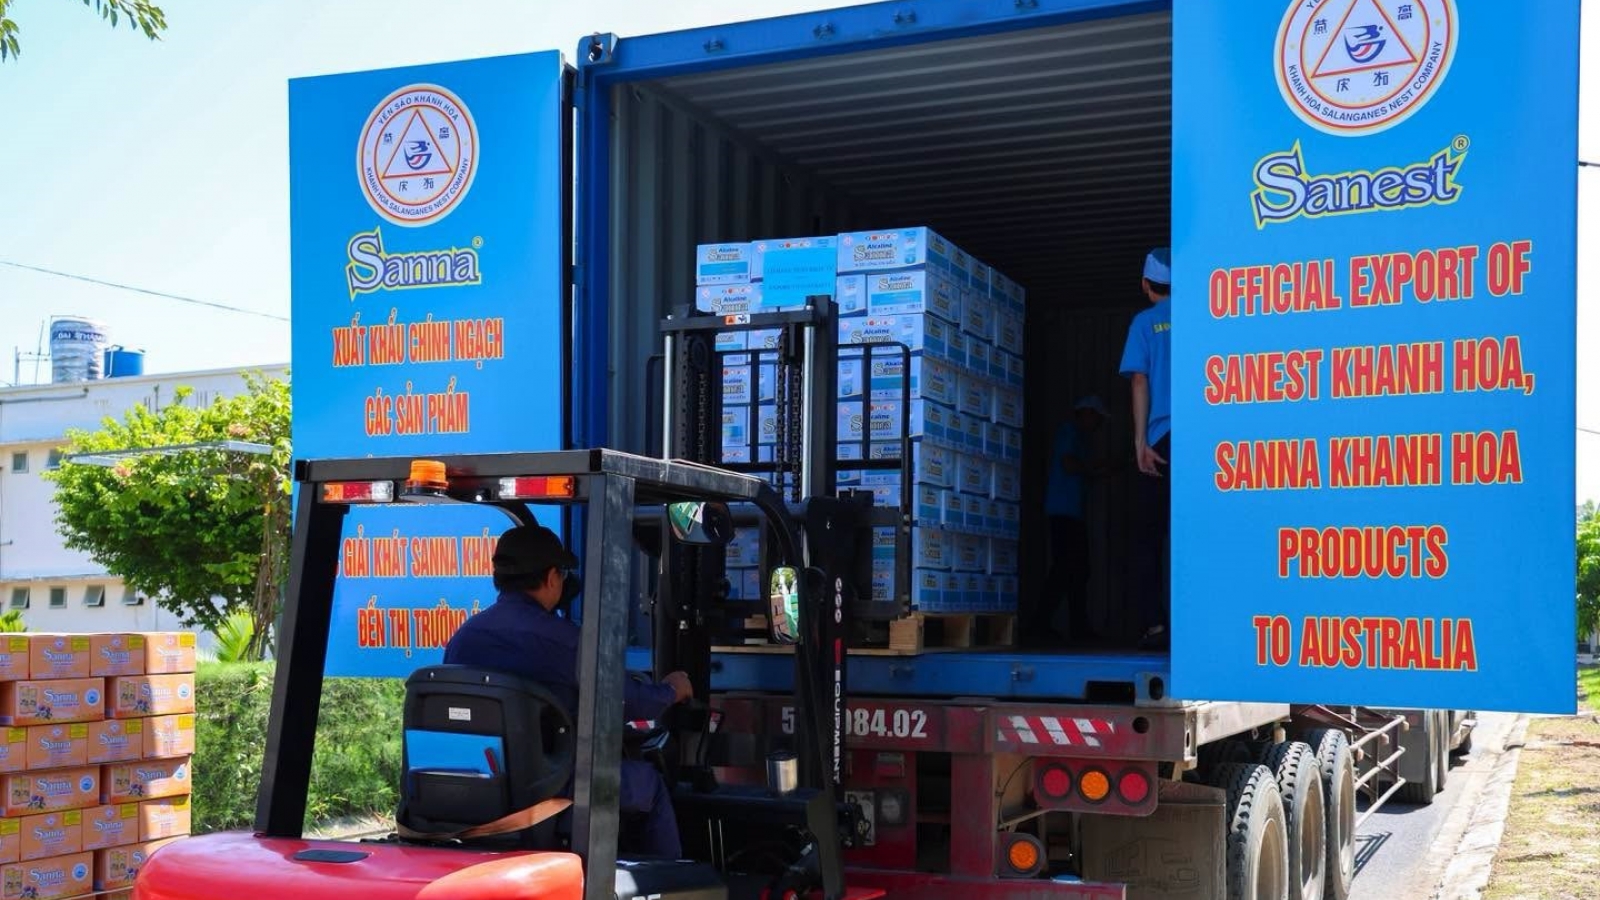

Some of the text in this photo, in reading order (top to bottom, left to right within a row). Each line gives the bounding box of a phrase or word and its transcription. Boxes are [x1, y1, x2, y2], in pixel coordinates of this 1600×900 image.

[1288, 41, 1443, 122] KHANH HOA SALANGANES NEST COMPANY
[366, 158, 469, 216] KHANH HOA SALANGANES NEST COMPANY
[1250, 138, 1468, 230] Sanest
[346, 226, 481, 301] Sanna
[1209, 239, 1532, 319] OFFICIAL EXPORT OF
[333, 308, 504, 369] XUẤT KHẨU CHÍNH NGẠCH
[1204, 335, 1535, 406] SANEST KHANH HOA,
[365, 376, 470, 436] CÁC SẢN PHẨM
[1214, 429, 1524, 491] SANNA KHANH HOA
[343, 524, 500, 578] GIẢI KHÁT SANNA KHÁN
[1278, 524, 1450, 579] PRODUCTS
[357, 595, 387, 649] ĐẾN
[389, 608, 411, 657] THỊ
[1252, 614, 1479, 672] TO AUSTRALIA
[43, 689, 78, 703] Sanna
[39, 737, 72, 750] Sanna
[36, 777, 73, 792] Sanna
